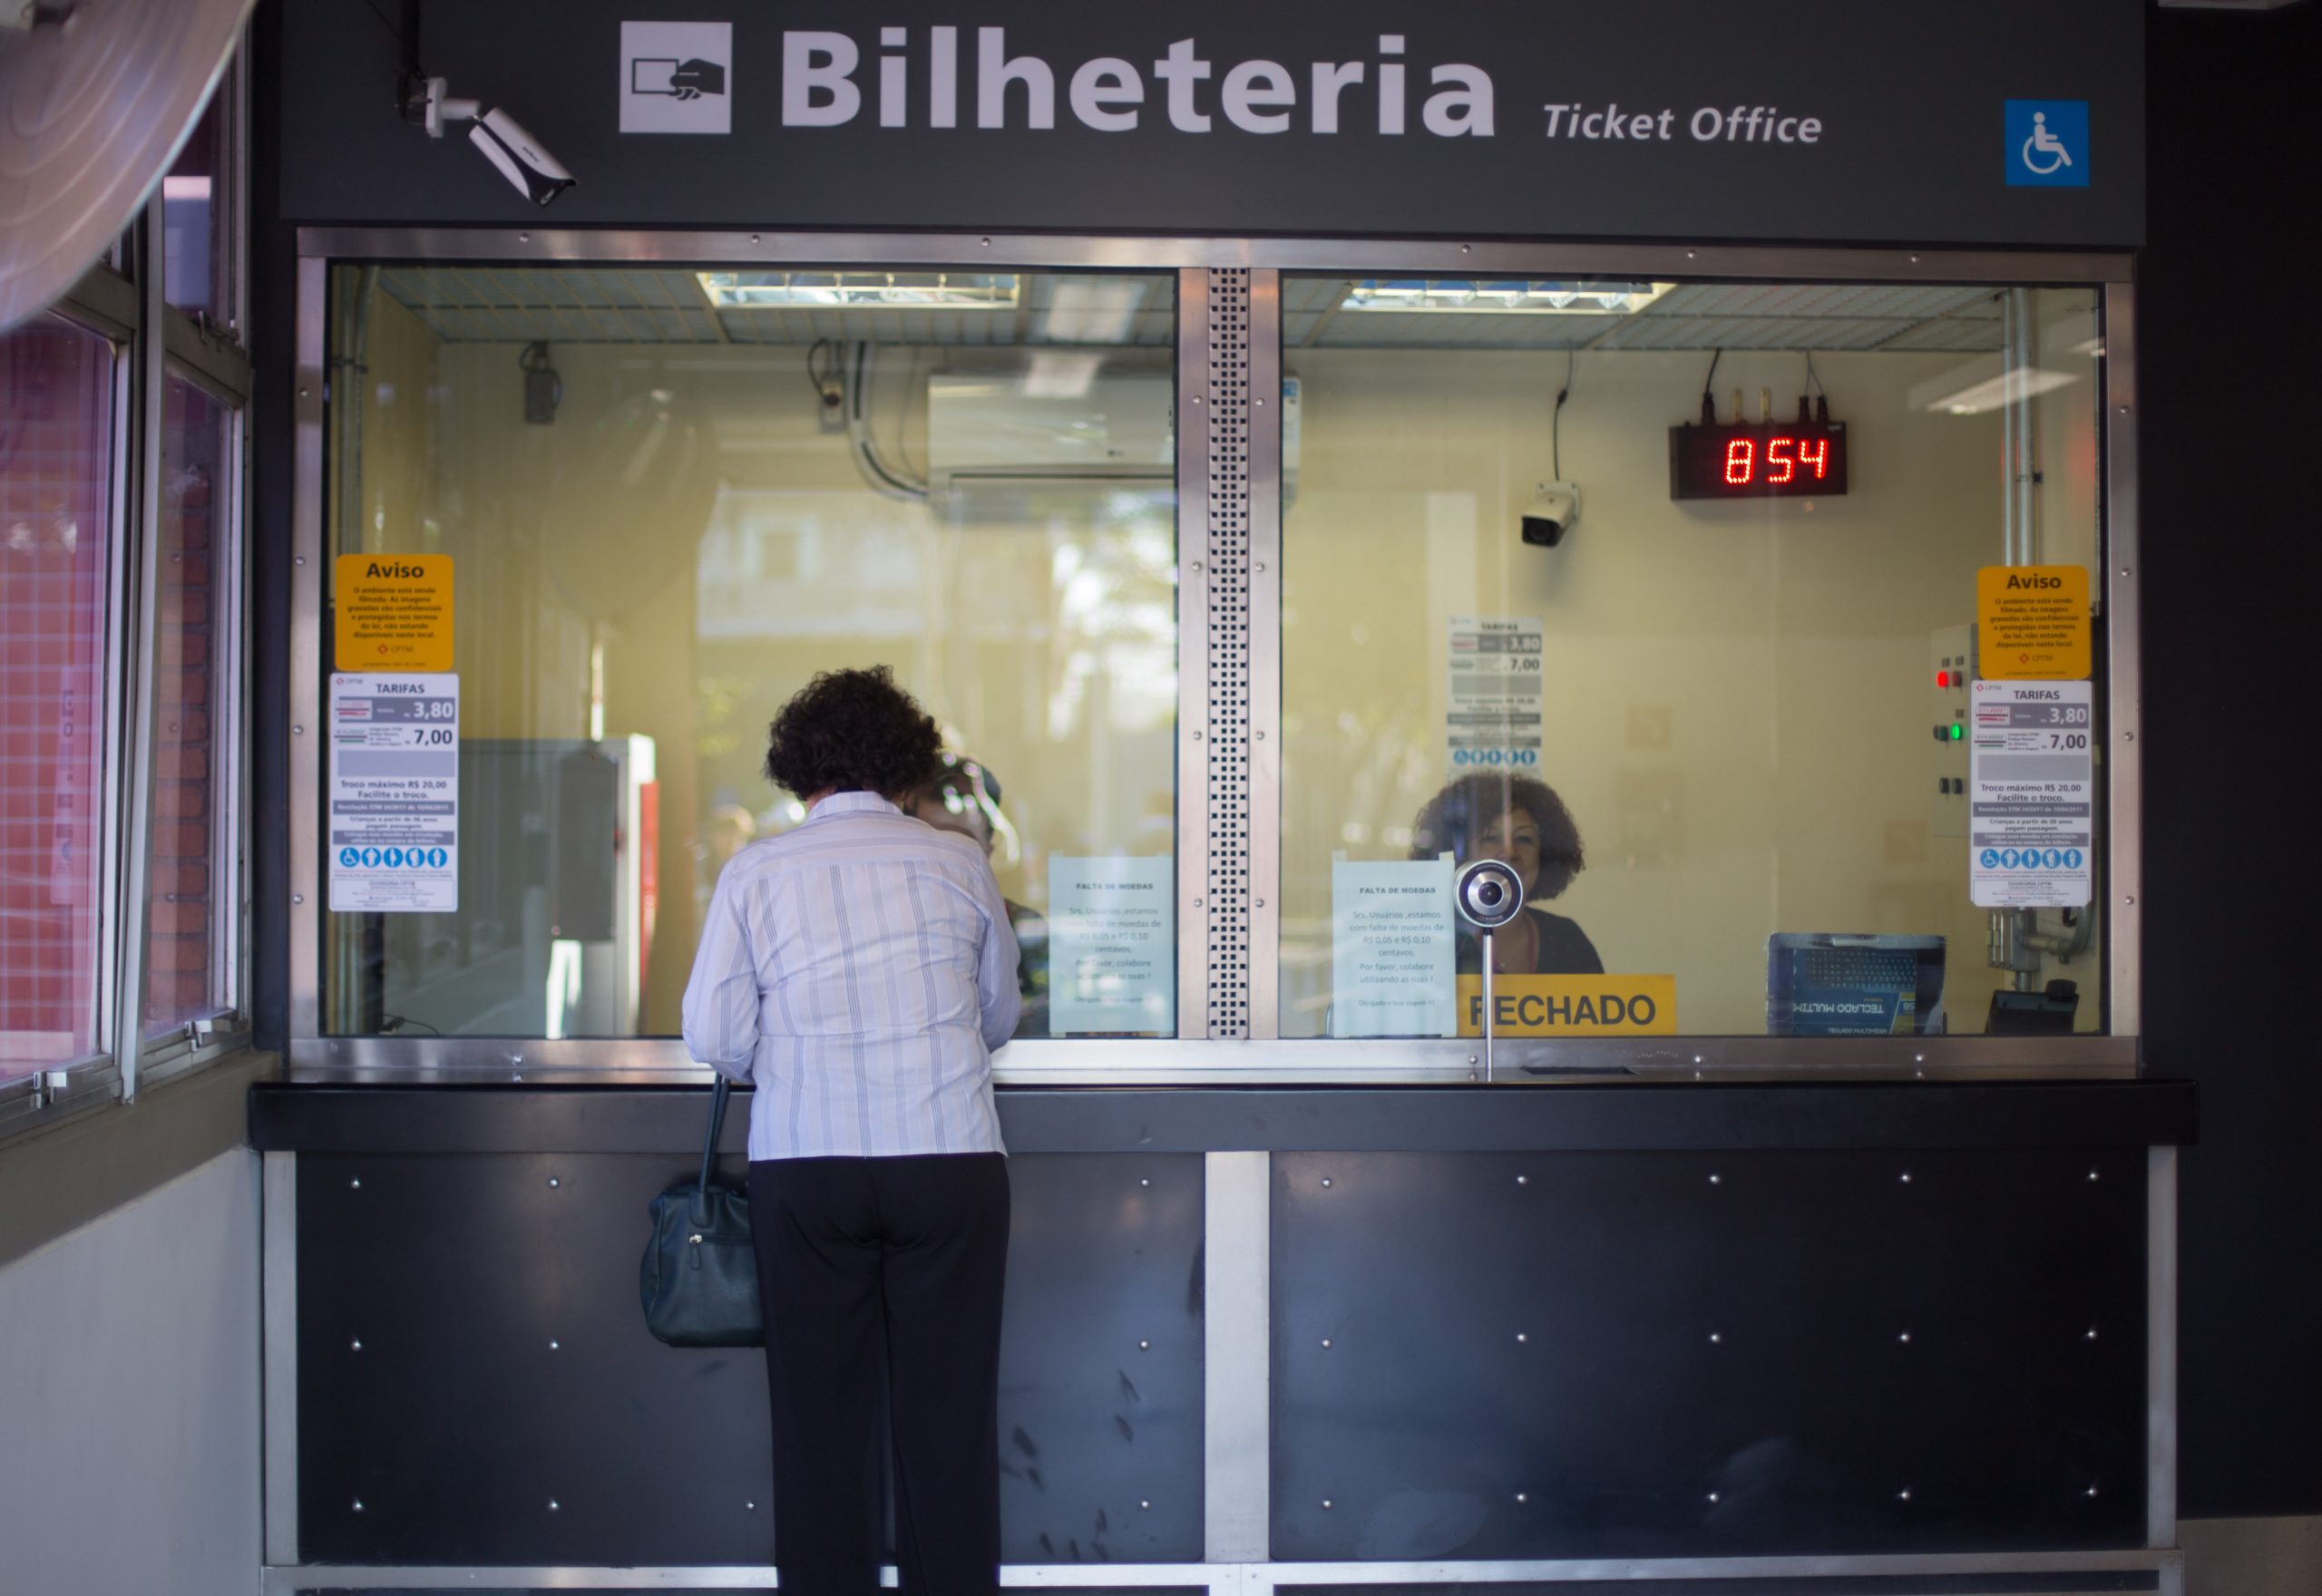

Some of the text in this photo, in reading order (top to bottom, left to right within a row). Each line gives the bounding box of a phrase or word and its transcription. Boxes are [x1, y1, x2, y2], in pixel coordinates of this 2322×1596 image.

[780, 26, 1497, 138] Bilheteria
[1542, 103, 1822, 145] Ticket Office
[366, 562, 424, 579] Aviso
[2007, 574, 2062, 589] Aviso
[1510, 659, 1540, 671] 7,00
[376, 684, 424, 693] TARIFAS
[2015, 691, 2060, 700] TARIFAS
[414, 702, 454, 720] 3,80
[2050, 708, 2086, 725] 3,80
[415, 729, 453, 746] 7,00
[2051, 735, 2086, 751] 7,00
[408, 781, 419, 789] R$
[422, 781, 446, 789] 20,00
[2045, 783, 2055, 793] R$
[2058, 783, 2081, 793] 20,00
[1370, 910, 1403, 919] Usuários
[1376, 937, 1392, 945] 0,05
[1401, 936, 1411, 944] R$
[1375, 963, 1398, 971] favor,
[1360, 976, 1399, 984] utilizando
[1469, 995, 1654, 1026] FECHADO
[1837, 1003, 1884, 1014] TECLADO
